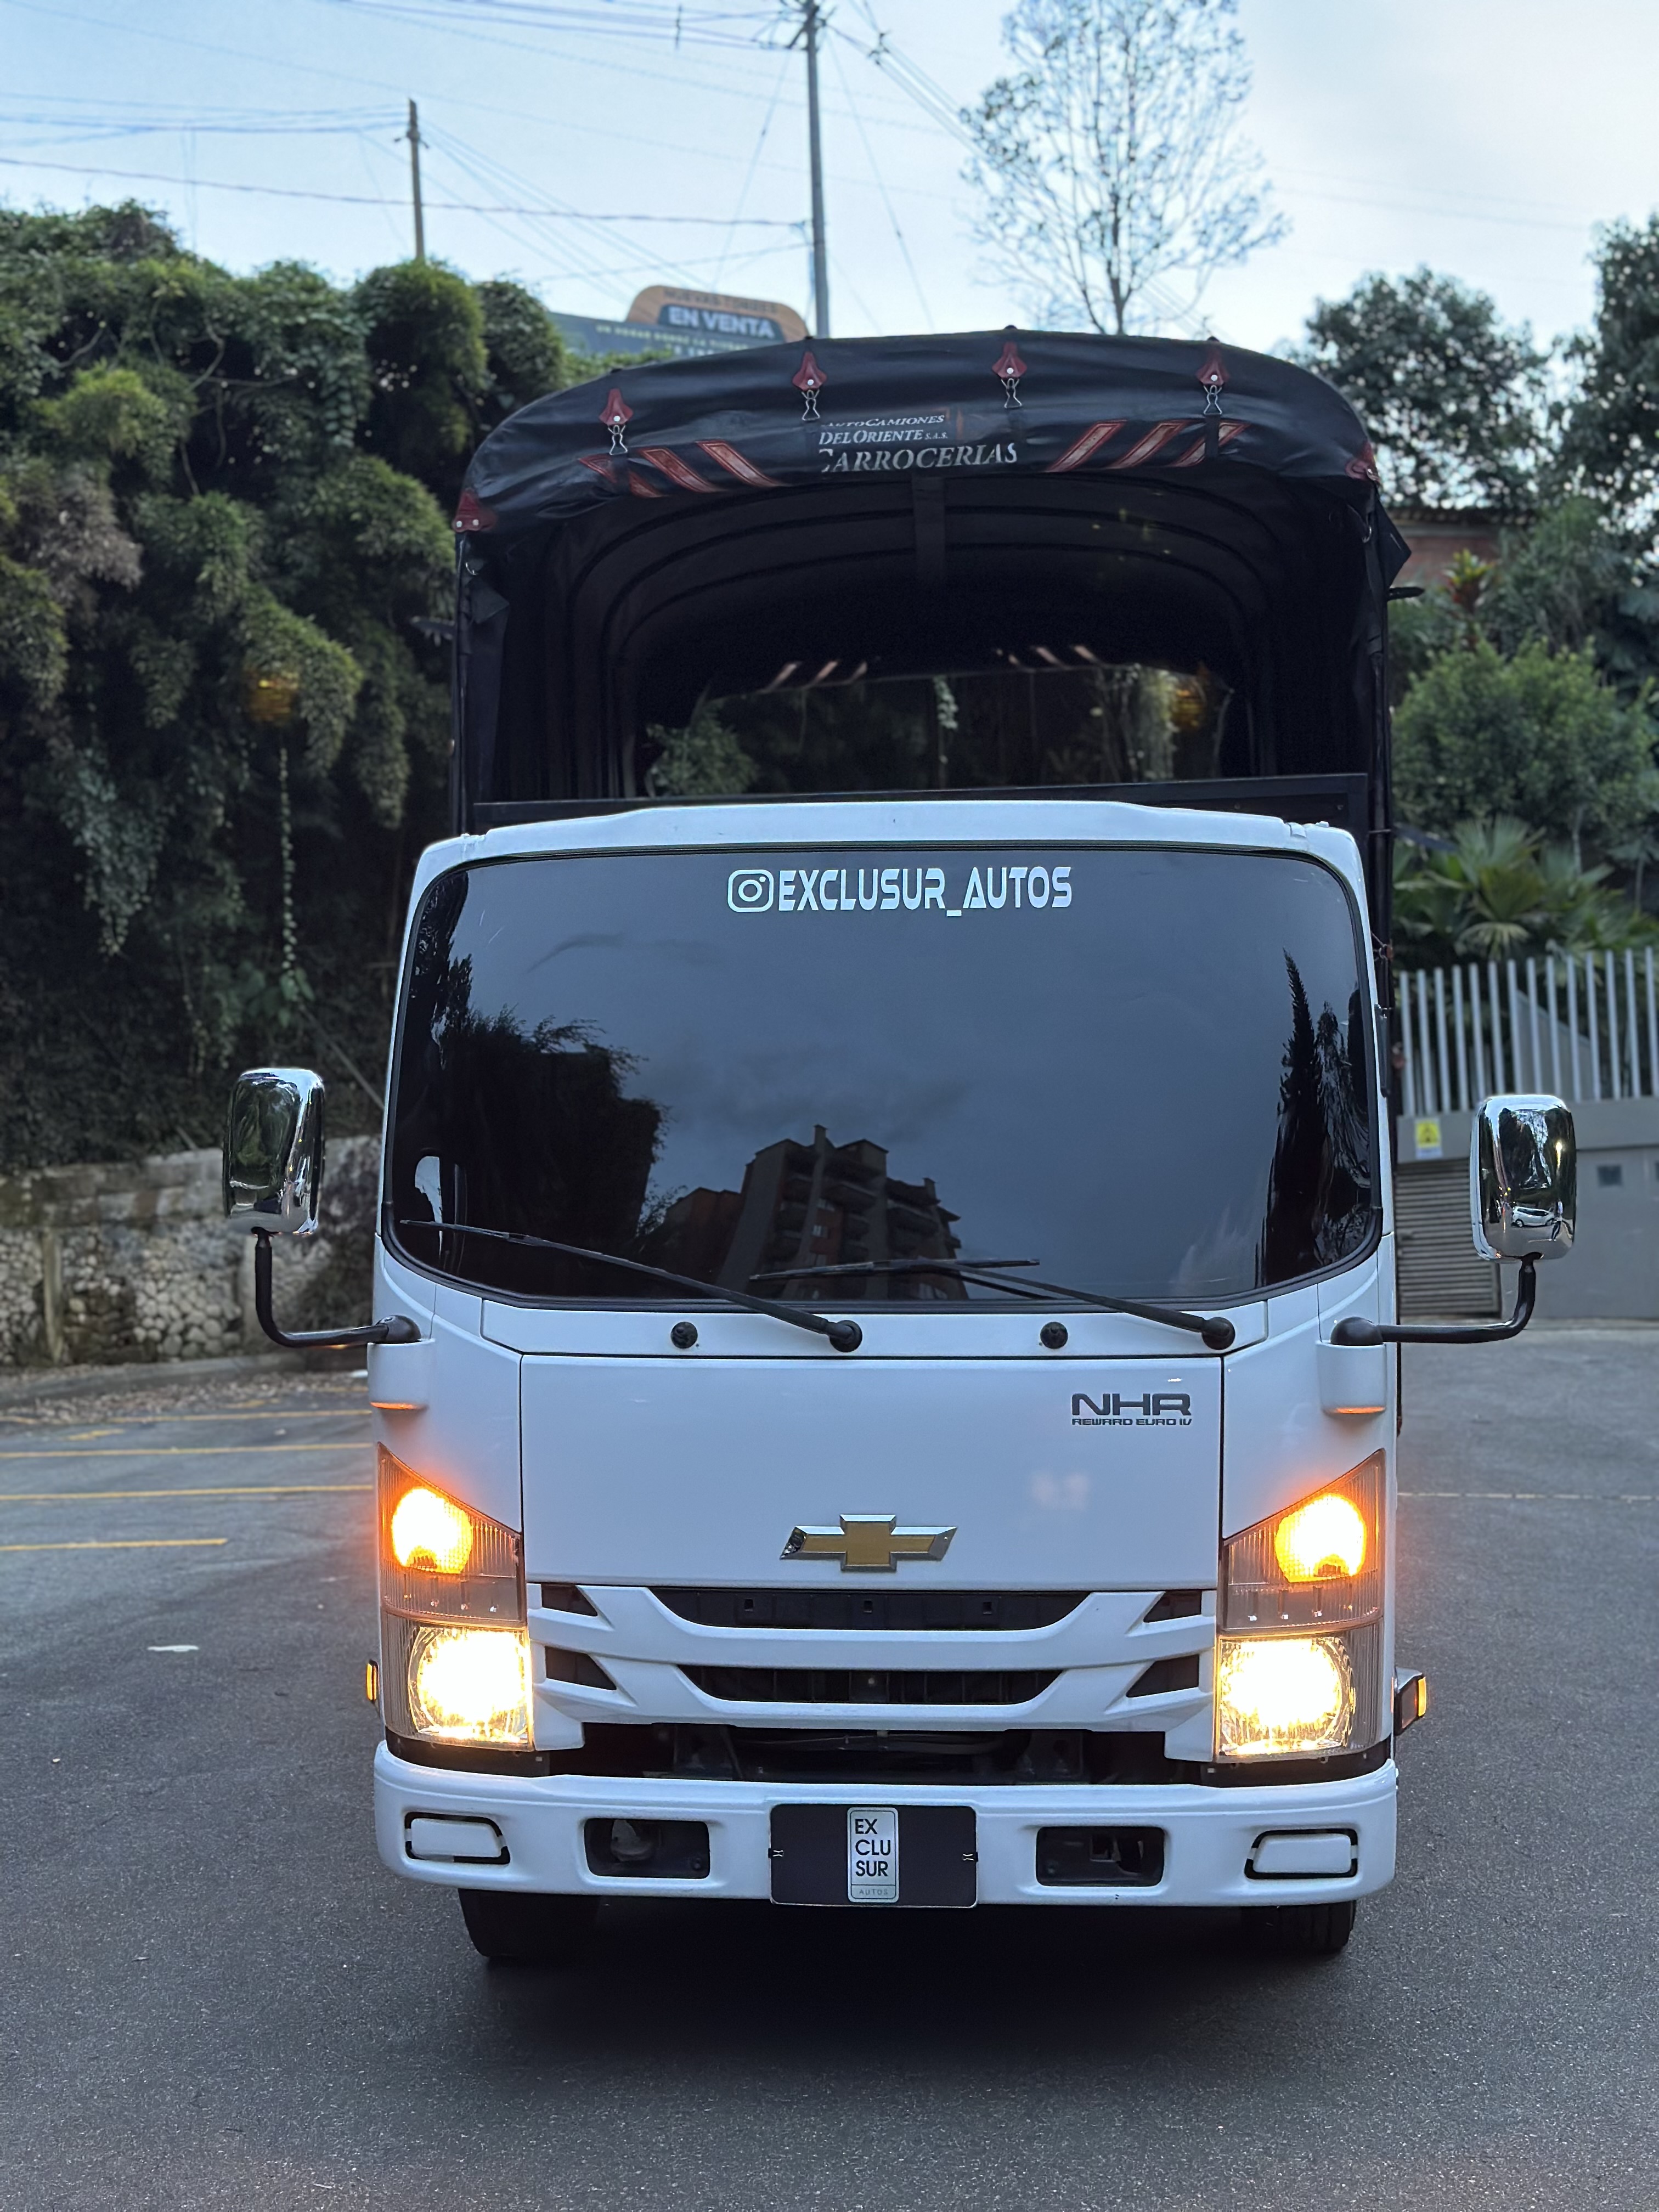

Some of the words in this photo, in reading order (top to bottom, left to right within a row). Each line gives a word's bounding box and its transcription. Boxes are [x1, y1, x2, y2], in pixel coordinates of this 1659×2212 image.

[668, 306, 699, 328] EN
[702, 310, 775, 339] VENTA
[821, 415, 945, 427] UTOCAMIONES
[778, 866, 1072, 917] EXCLUSUR_AUTOS
[1072, 1393, 1192, 1416] NHR
[855, 1819, 878, 1835] EX
[855, 1839, 891, 1855] CLU
[855, 1860, 889, 1877] SUR
